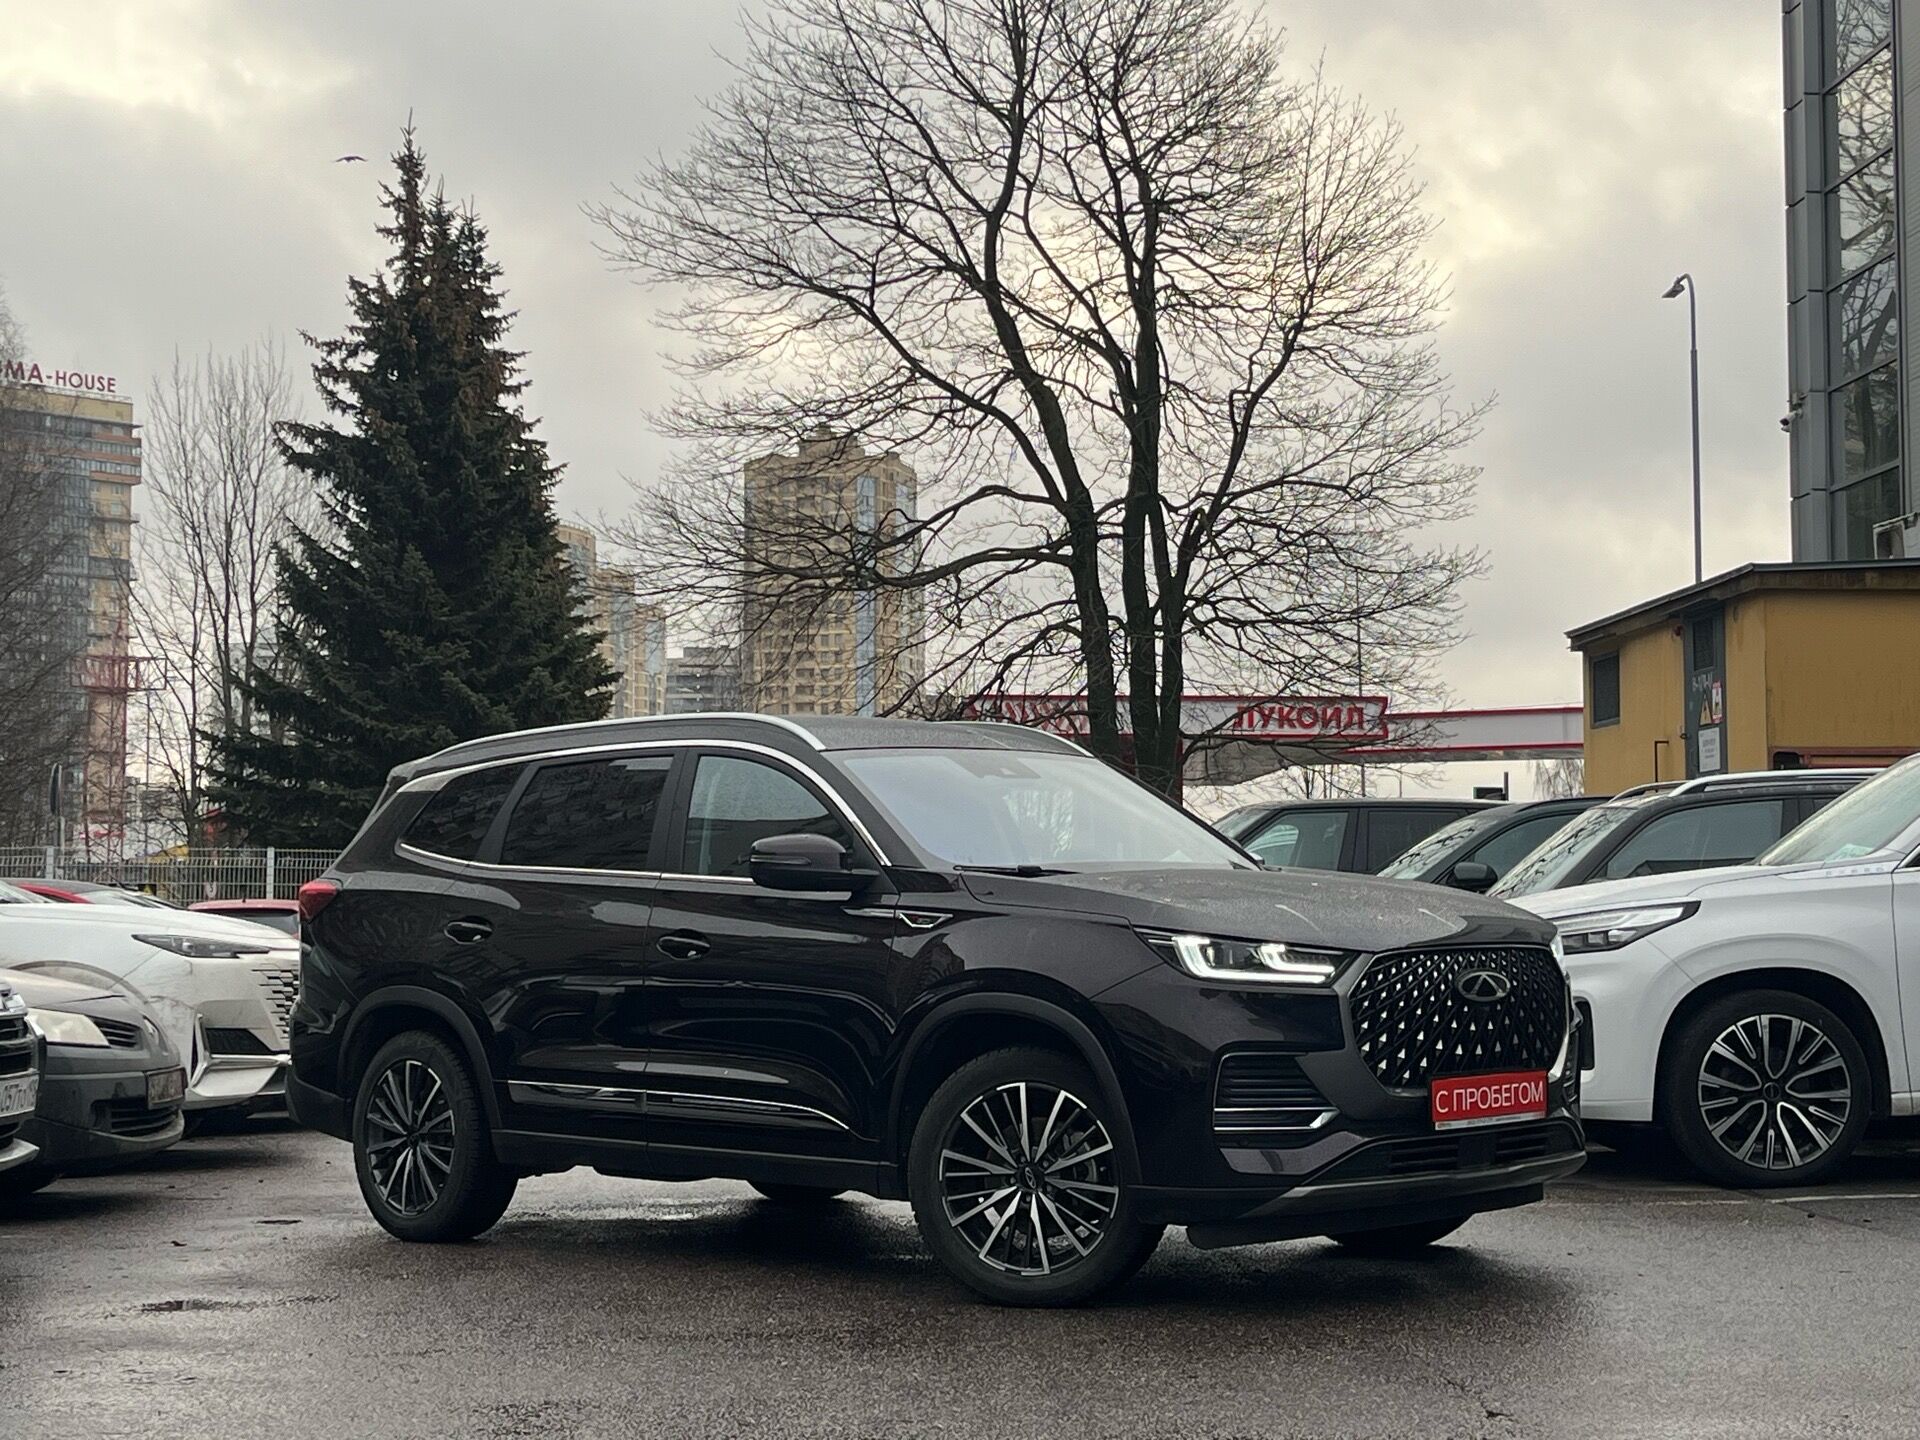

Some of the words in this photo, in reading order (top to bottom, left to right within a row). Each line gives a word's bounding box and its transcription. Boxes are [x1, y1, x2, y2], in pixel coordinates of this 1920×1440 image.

[0, 359, 116, 393] MA-HOUSE
[1435, 1090, 1449, 1113] С
[1453, 1081, 1544, 1112] ПРОБЕГОМ
